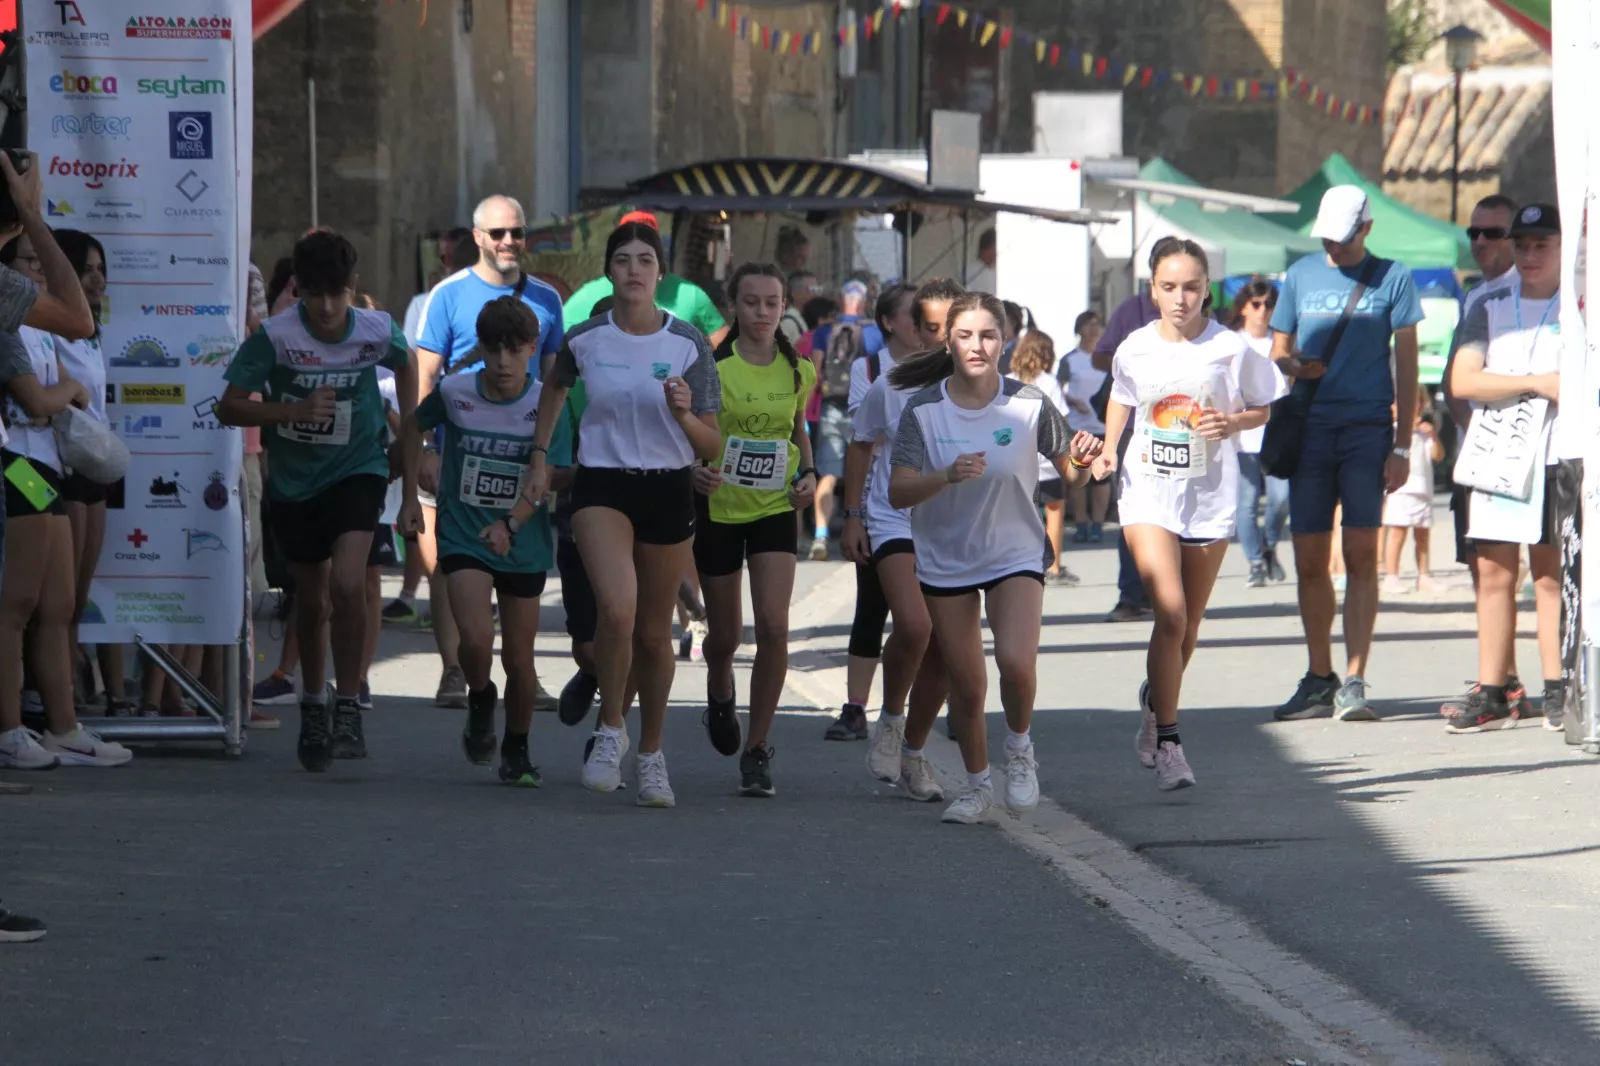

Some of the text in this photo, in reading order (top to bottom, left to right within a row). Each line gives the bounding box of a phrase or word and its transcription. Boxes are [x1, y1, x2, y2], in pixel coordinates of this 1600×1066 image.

[126, 15, 232, 28] ALTOARAGÓN
[36, 32, 110, 41] TRALLERO
[136, 29, 222, 37] SUPERMERCADOS
[50, 69, 118, 94] eboca
[137, 75, 226, 98] seytam
[49, 156, 139, 181] fotoprix
[164, 207, 222, 216] CUARZOS
[156, 305, 231, 316] INTERSPORT
[292, 371, 361, 387] ATLEET
[123, 386, 171, 397] barrabes
[457, 435, 533, 457] ATLEET
[1153, 444, 1189, 465] 506
[739, 456, 774, 475] 502
[478, 476, 515, 496] 505
